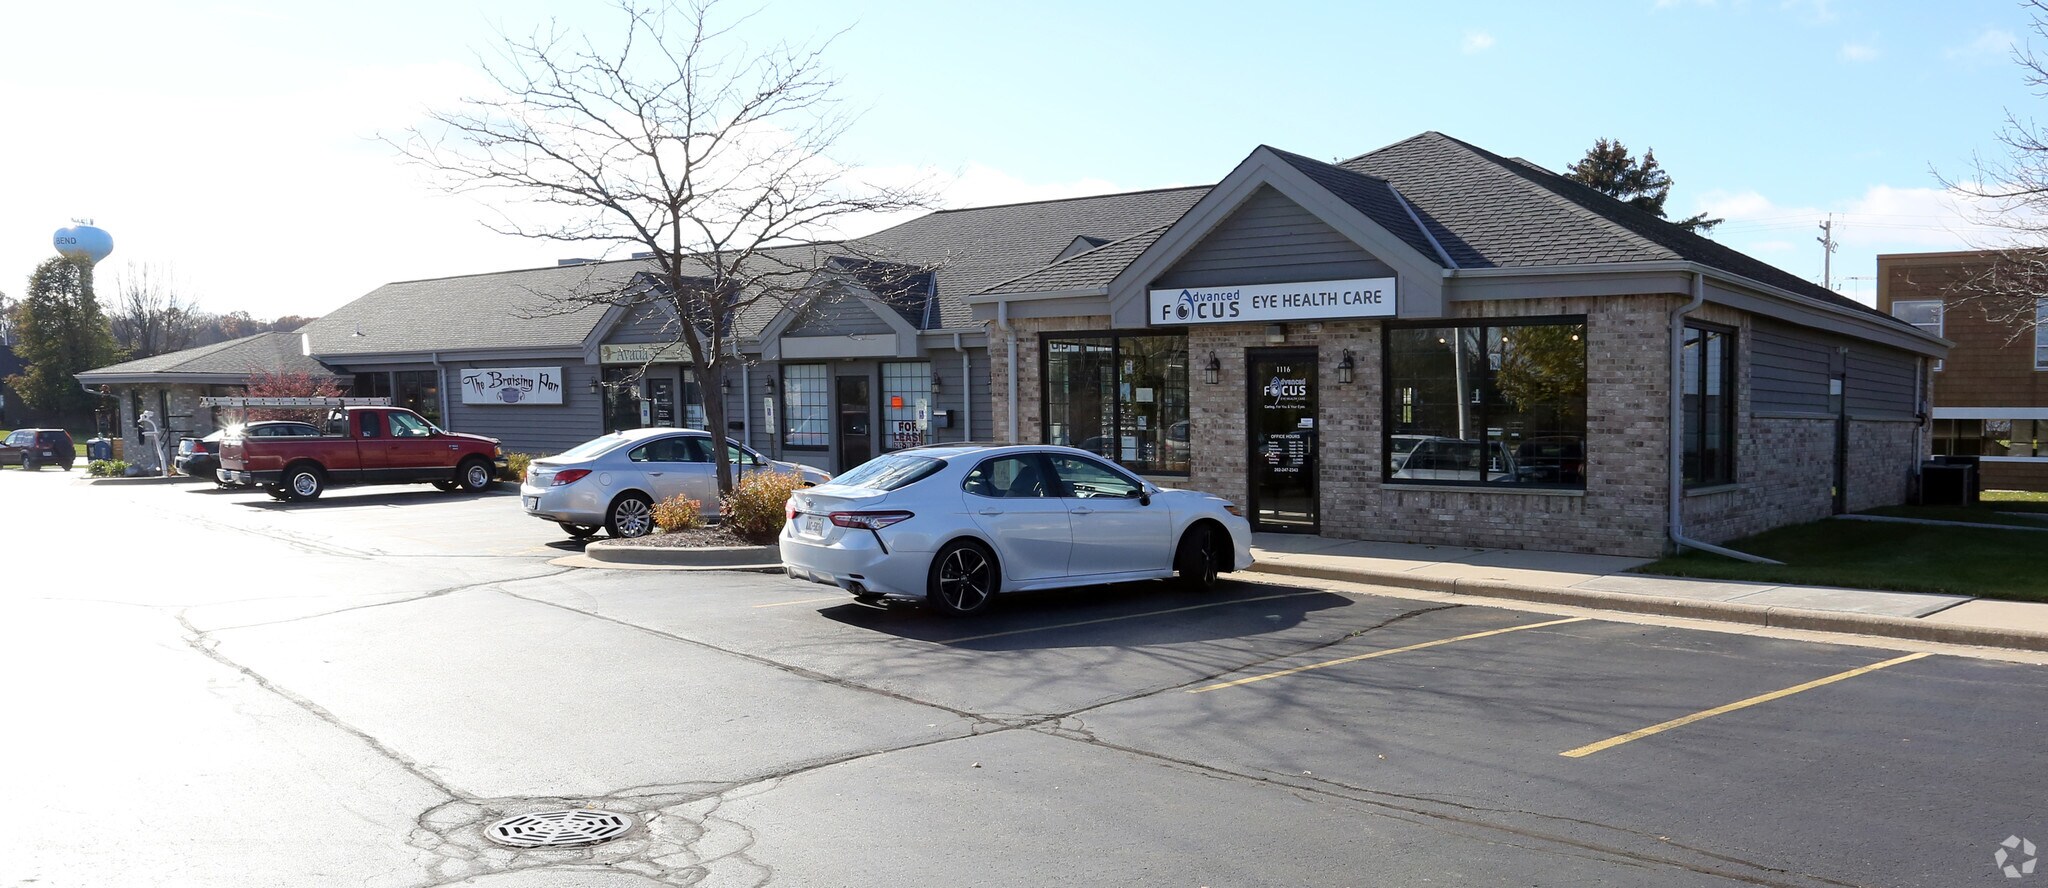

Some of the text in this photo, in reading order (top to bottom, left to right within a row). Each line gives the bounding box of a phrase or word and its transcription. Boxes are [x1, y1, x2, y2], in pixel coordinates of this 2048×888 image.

[55, 236, 77, 245] BEND
[1252, 290, 1382, 309] EYE HEALTH CARE
[463, 371, 559, 397] The Braising Pan
[899, 422, 918, 431] FOR
